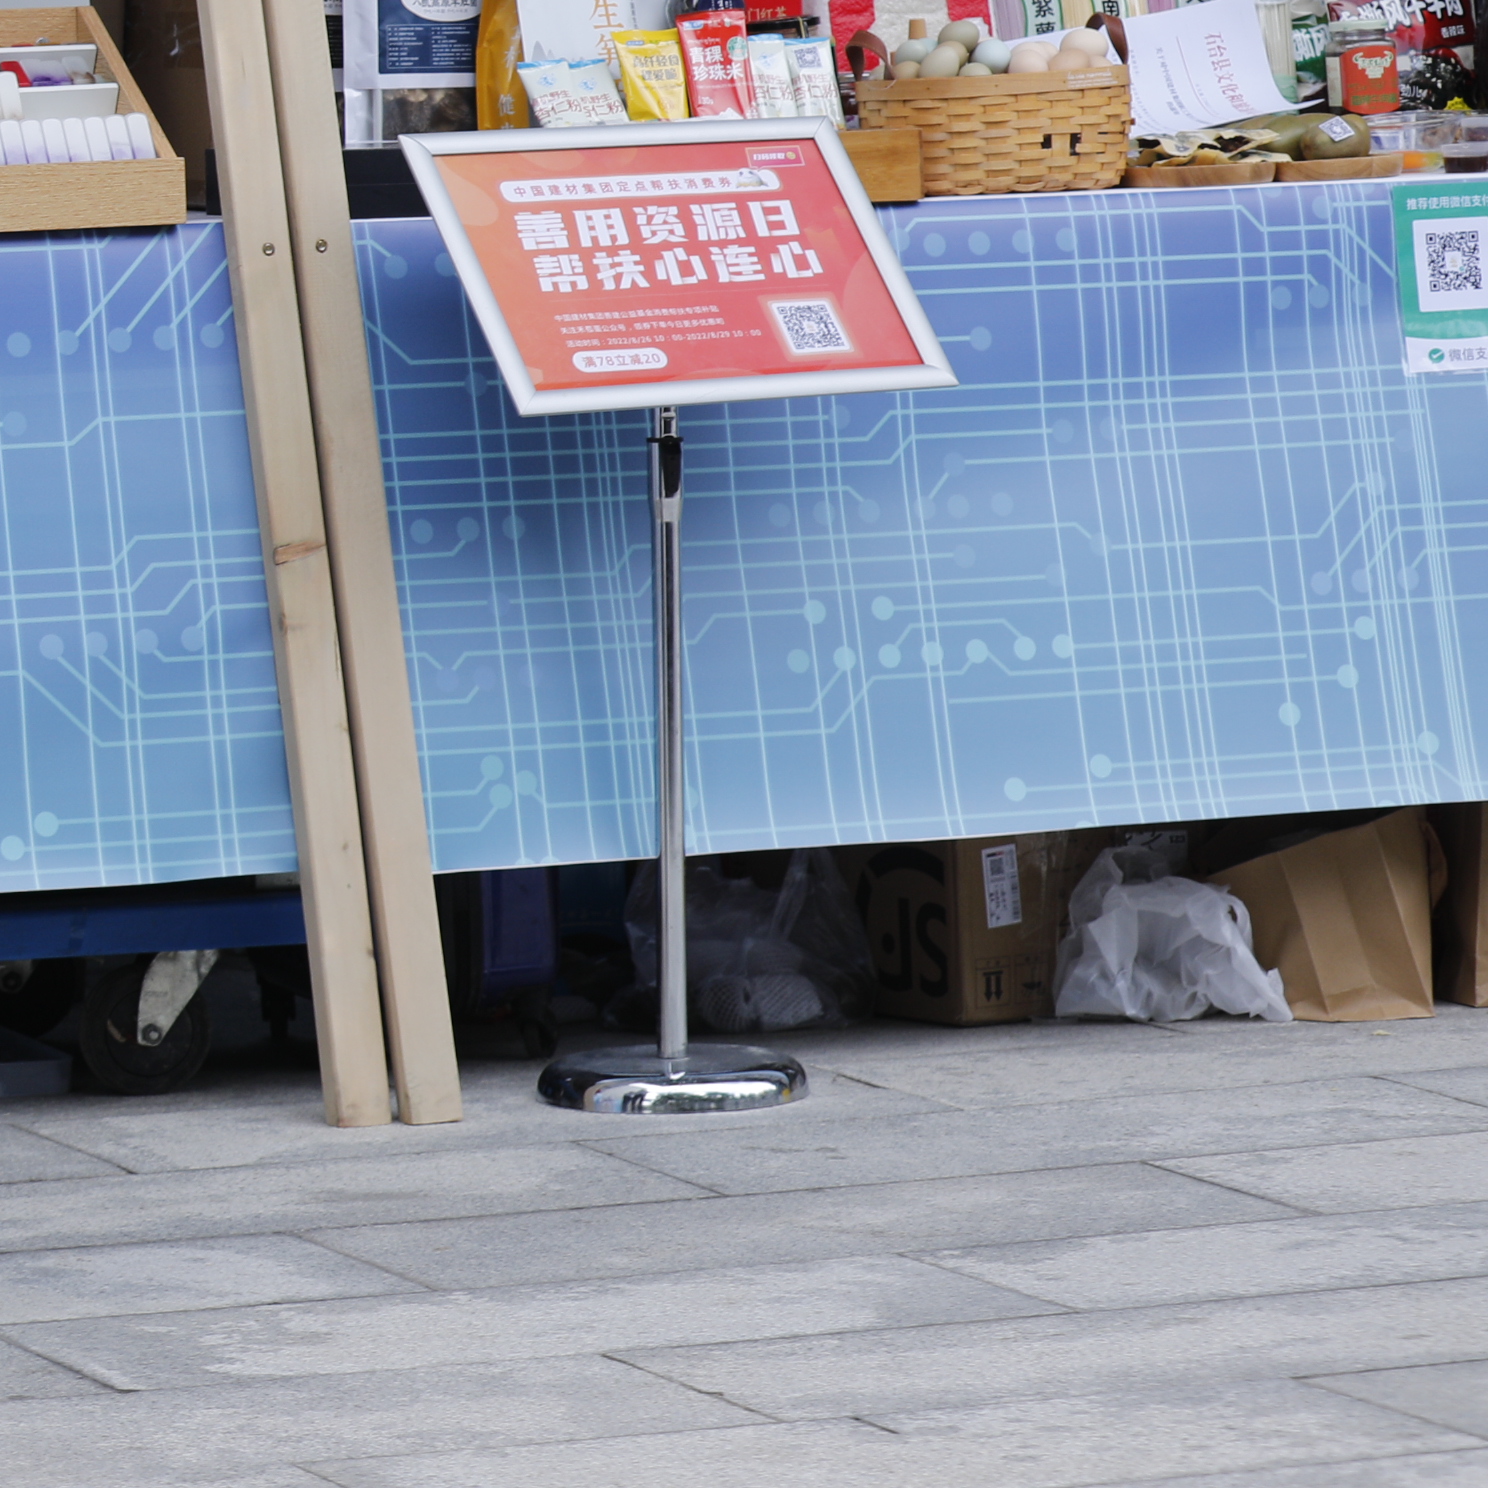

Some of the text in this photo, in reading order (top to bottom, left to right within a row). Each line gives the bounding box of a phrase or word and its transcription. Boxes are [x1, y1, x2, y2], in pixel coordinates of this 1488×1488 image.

[689, 45, 723, 63] 青稞
[693, 62, 744, 81] 珍珠米
[513, 176, 733, 199] 中国建材集团定点帮扶消费券
[513, 199, 801, 251] 善用资源日
[532, 241, 824, 294] 帮扶心连心
[581, 352, 662, 369] 满78立减20
